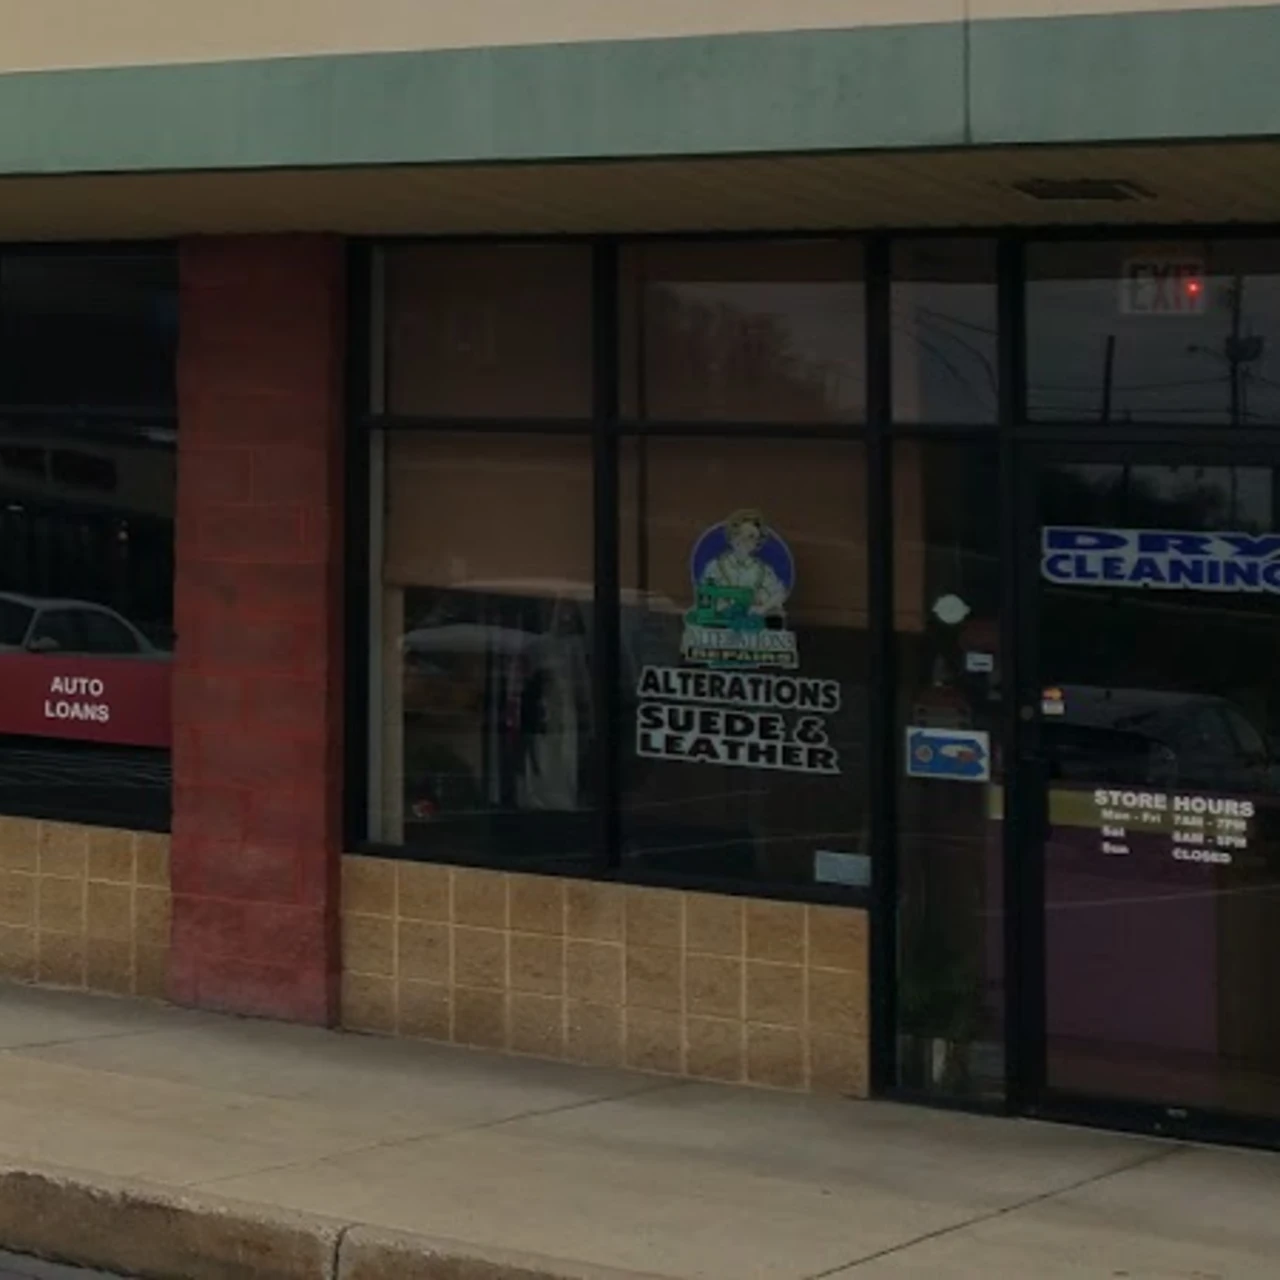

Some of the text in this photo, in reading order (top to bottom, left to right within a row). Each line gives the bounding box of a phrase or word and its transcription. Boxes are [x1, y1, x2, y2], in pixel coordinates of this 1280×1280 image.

[1130, 263, 1201, 312] EXIT
[1046, 529, 1280, 558] DRY
[50, 676, 105, 697] AUTO
[639, 668, 839, 710] ALTERATIONS
[44, 699, 110, 723] LOANS
[639, 704, 827, 744] SUEDE &
[639, 732, 836, 769] LEATHER
[1094, 789, 1256, 818] STORE HOURS
[1100, 808, 1131, 821] Mon
[1142, 811, 1162, 824] Fri
[1101, 825, 1126, 838] Sat
[1102, 841, 1232, 864] Sun CLOSED
